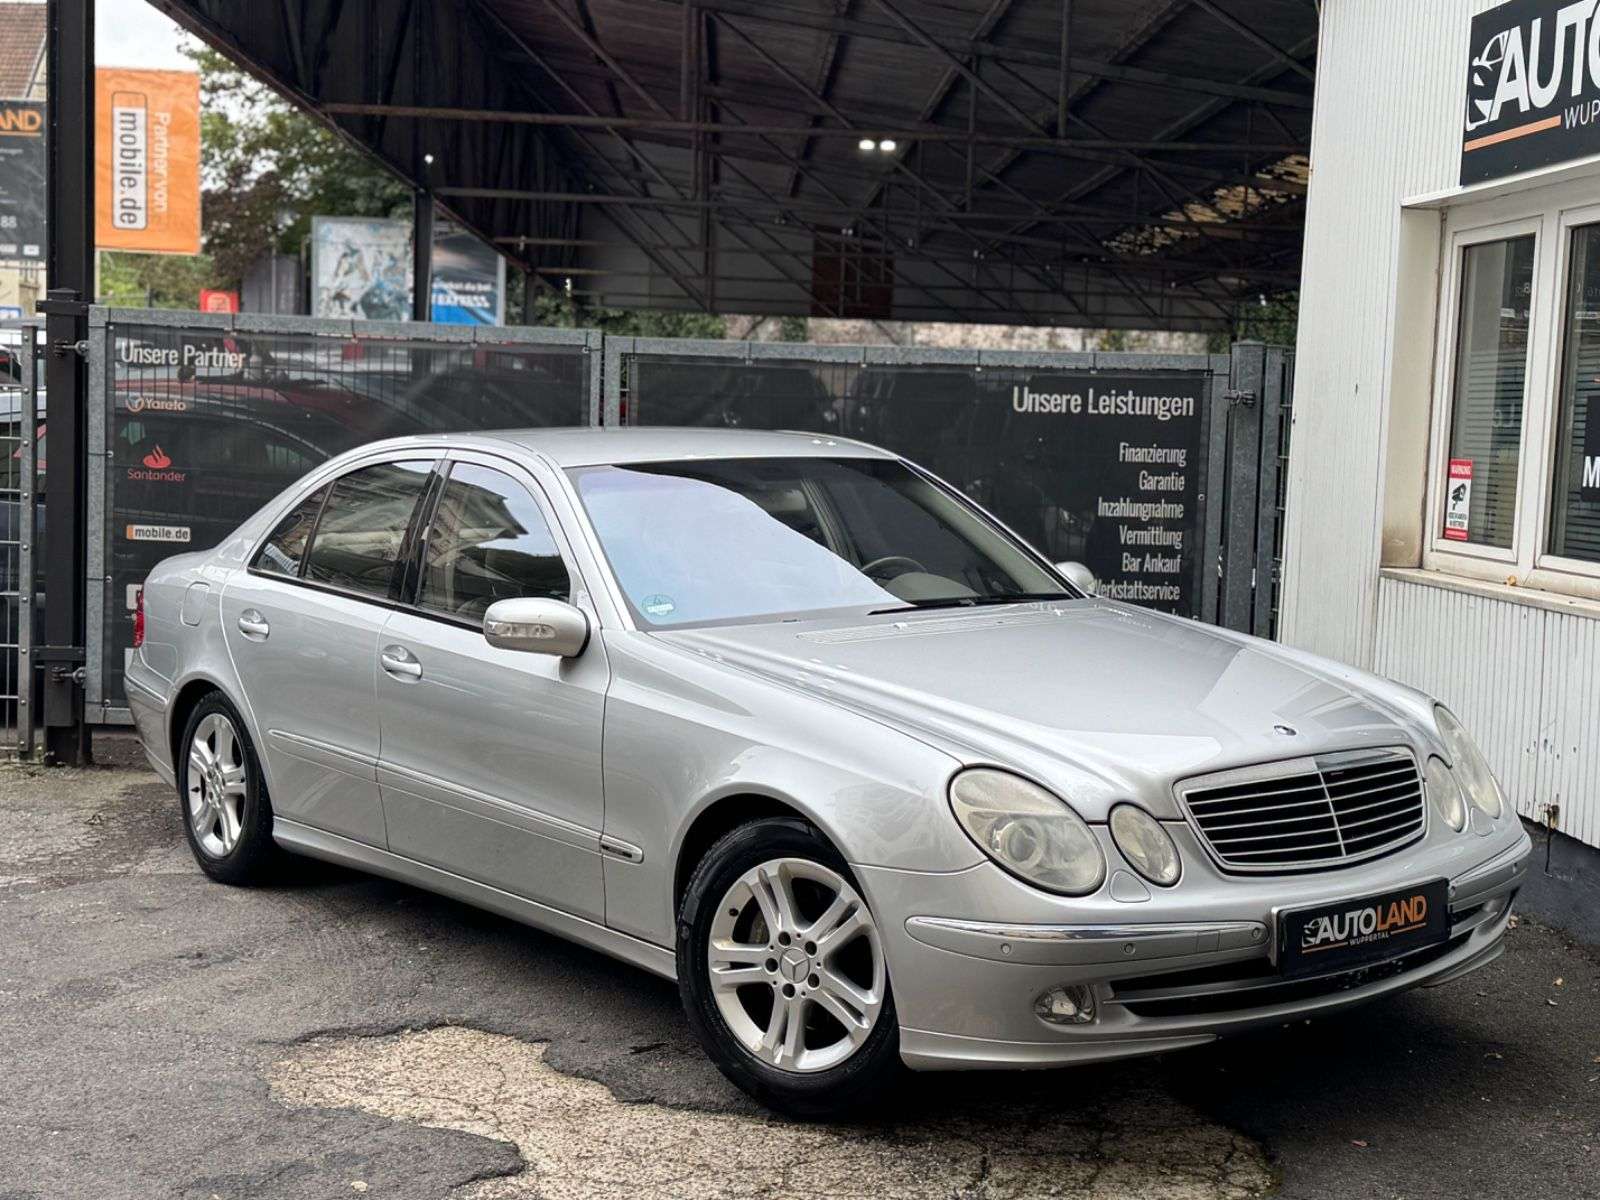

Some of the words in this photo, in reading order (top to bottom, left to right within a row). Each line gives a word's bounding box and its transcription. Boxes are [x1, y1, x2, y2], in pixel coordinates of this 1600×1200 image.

[1488, 0, 1600, 122] AUT
[152, 112, 171, 178] Partner
[119, 112, 142, 224] mobile.de
[153, 180, 167, 212] von
[121, 341, 179, 366] Unsere
[183, 344, 247, 368] Partner
[1013, 386, 1082, 413] Unsere
[1088, 388, 1194, 420] Leistungen
[1119, 442, 1187, 467] Finanzierung
[127, 468, 186, 482] Santander
[1139, 470, 1186, 492] Garantie
[1098, 497, 1185, 522] Inzahlungnahme
[1119, 525, 1184, 549] Vermittlung
[1122, 552, 1140, 573] Bar
[1143, 553, 1183, 574] Ankauf
[1315, 895, 1428, 944] AUTOLAND
